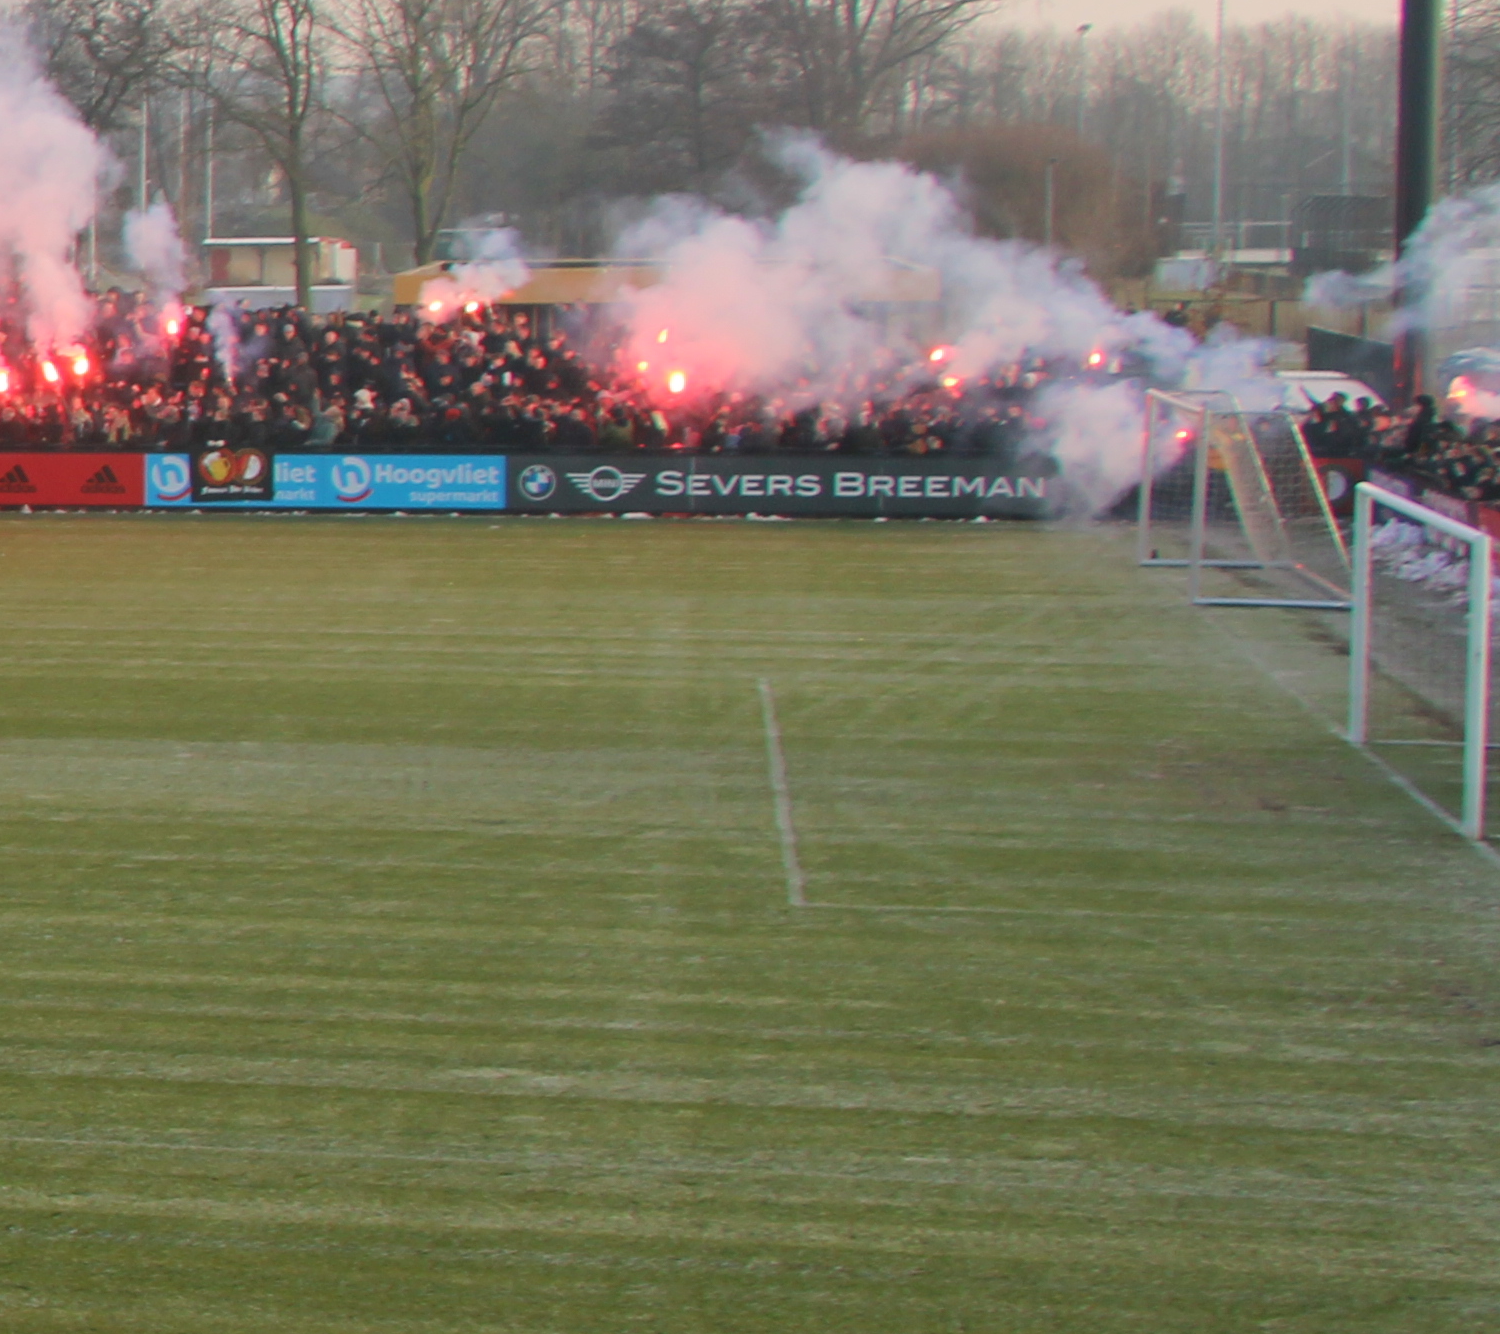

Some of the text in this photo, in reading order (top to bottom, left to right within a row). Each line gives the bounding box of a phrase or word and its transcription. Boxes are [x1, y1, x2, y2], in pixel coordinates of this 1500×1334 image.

[375, 463, 500, 488] Hoogvliet
[655, 470, 1048, 499] SEVERS BREEMAN
[410, 489, 499, 505] supermarkt
